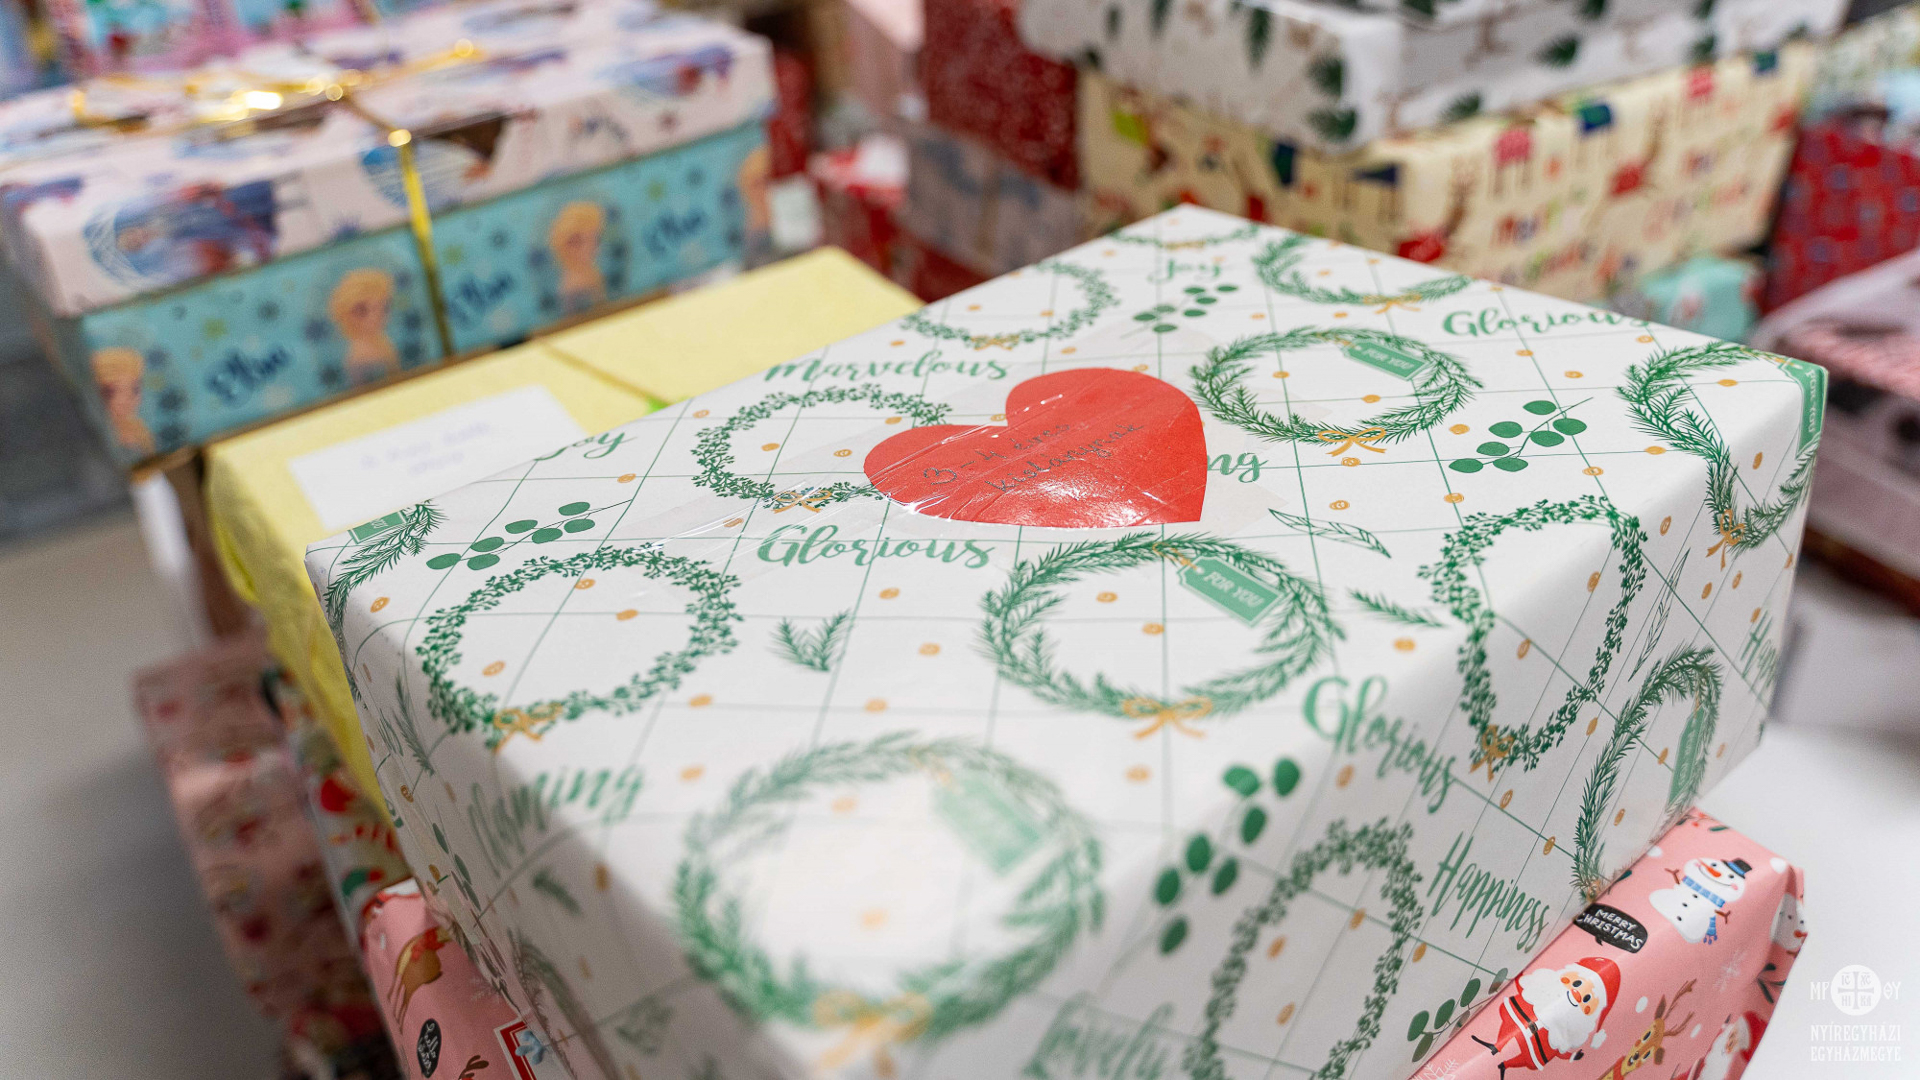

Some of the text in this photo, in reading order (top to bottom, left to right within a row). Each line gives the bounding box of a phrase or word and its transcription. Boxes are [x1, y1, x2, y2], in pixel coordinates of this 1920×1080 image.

[757, 524, 996, 569] Glorious
[1203, 571, 1264, 608] FOR YOU
[1302, 675, 1456, 815] Glorious
[1426, 831, 1549, 954] Happiness
[1595, 909, 1637, 931] MERRY
